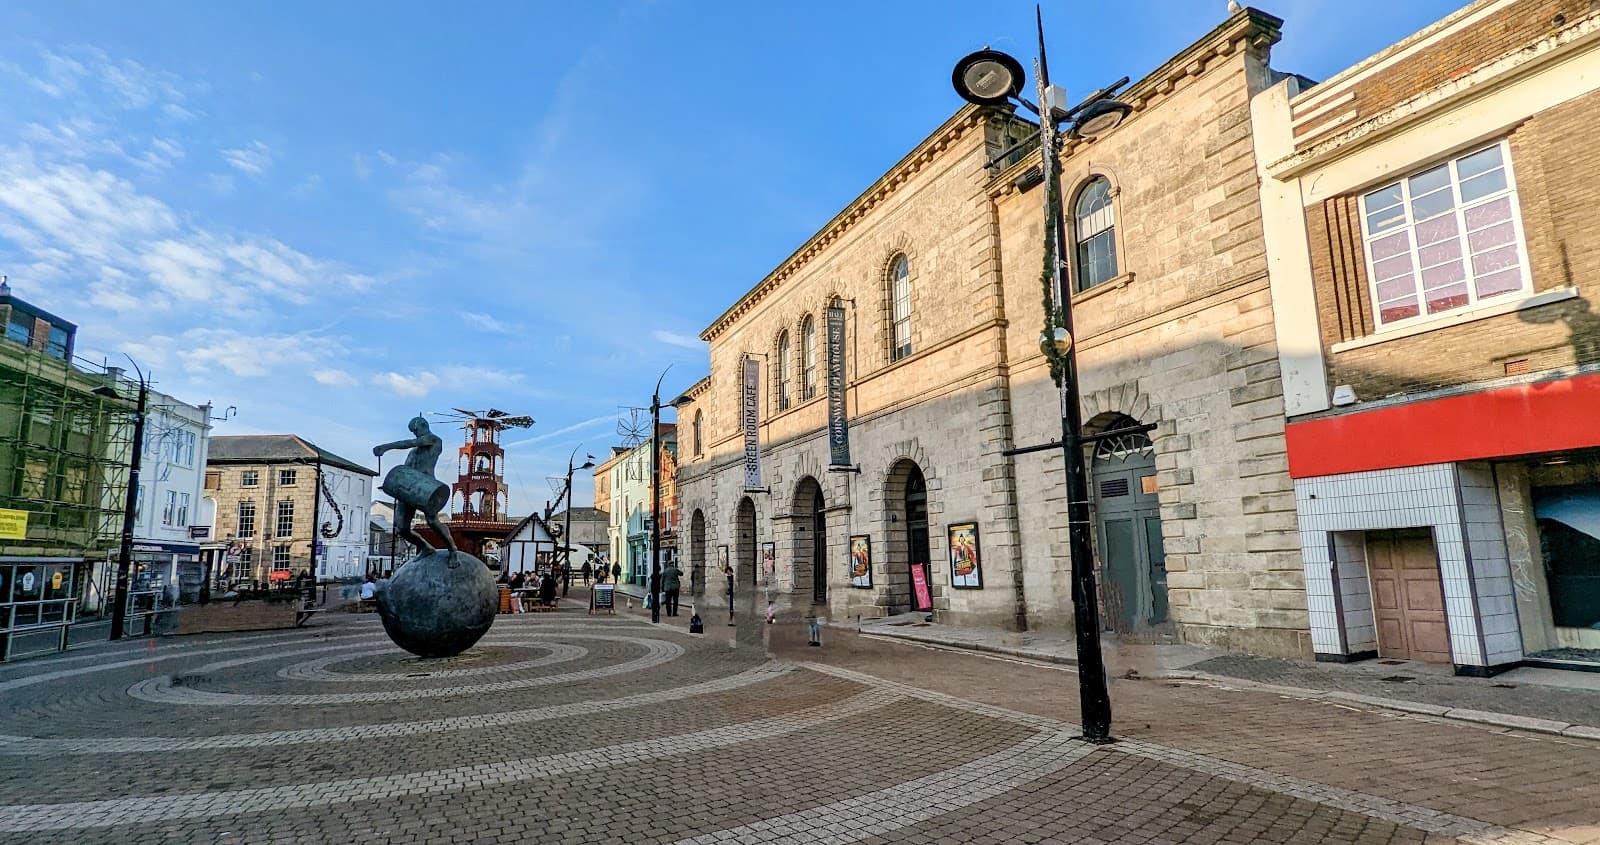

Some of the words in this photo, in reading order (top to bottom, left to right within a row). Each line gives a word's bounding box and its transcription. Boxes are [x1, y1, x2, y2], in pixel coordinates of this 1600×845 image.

[832, 327, 841, 386] PLAYHOUSE
[746, 410, 757, 436] ROOM
[833, 391, 843, 444] CORNWALL
[746, 440, 758, 471] GREEN
